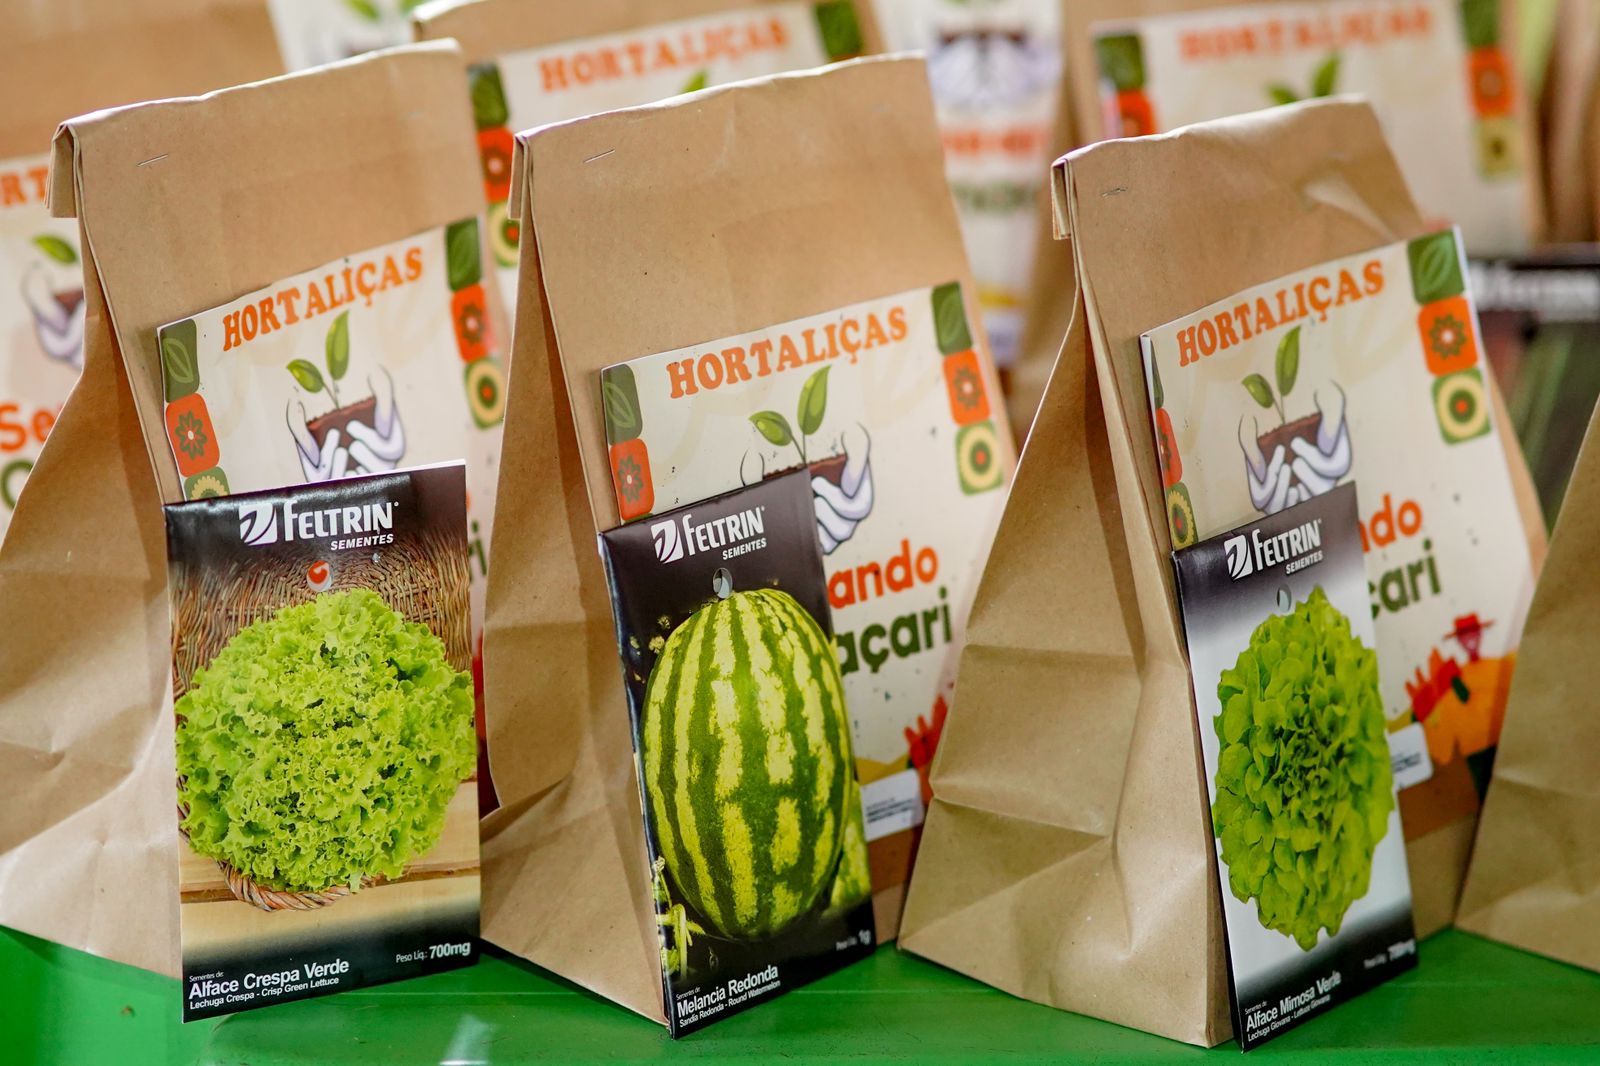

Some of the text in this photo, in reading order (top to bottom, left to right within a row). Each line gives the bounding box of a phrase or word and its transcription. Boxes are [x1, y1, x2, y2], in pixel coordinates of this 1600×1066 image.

[222, 246, 424, 351] HORTALIÇAS
[1176, 260, 1385, 367] HORTALIÇAS
[666, 306, 908, 399] HORTALIÇAS
[330, 533, 395, 551] SEMENTES
[722, 537, 768, 561] SEMENTES
[1285, 550, 1324, 575] SEMENTES
[395, 953, 413, 964] Peso
[429, 942, 471, 959] 700mg
[188, 958, 350, 1000] Alface Crespa Verde
[189, 973, 215, 983] Sementes
[190, 997, 224, 1010] Lechuga
[226, 992, 255, 1004] Crespa
[261, 987, 283, 998] Crisp
[284, 983, 309, 994] Green
[310, 976, 340, 989] Lettuce
[677, 964, 779, 1018] Melancia Redonda
[699, 1003, 725, 1020] Redonda
[728, 994, 748, 1008] Round
[1246, 970, 1342, 1033] Alface Mimosa Verde
[1247, 1026, 1270, 1042] Lechuga
